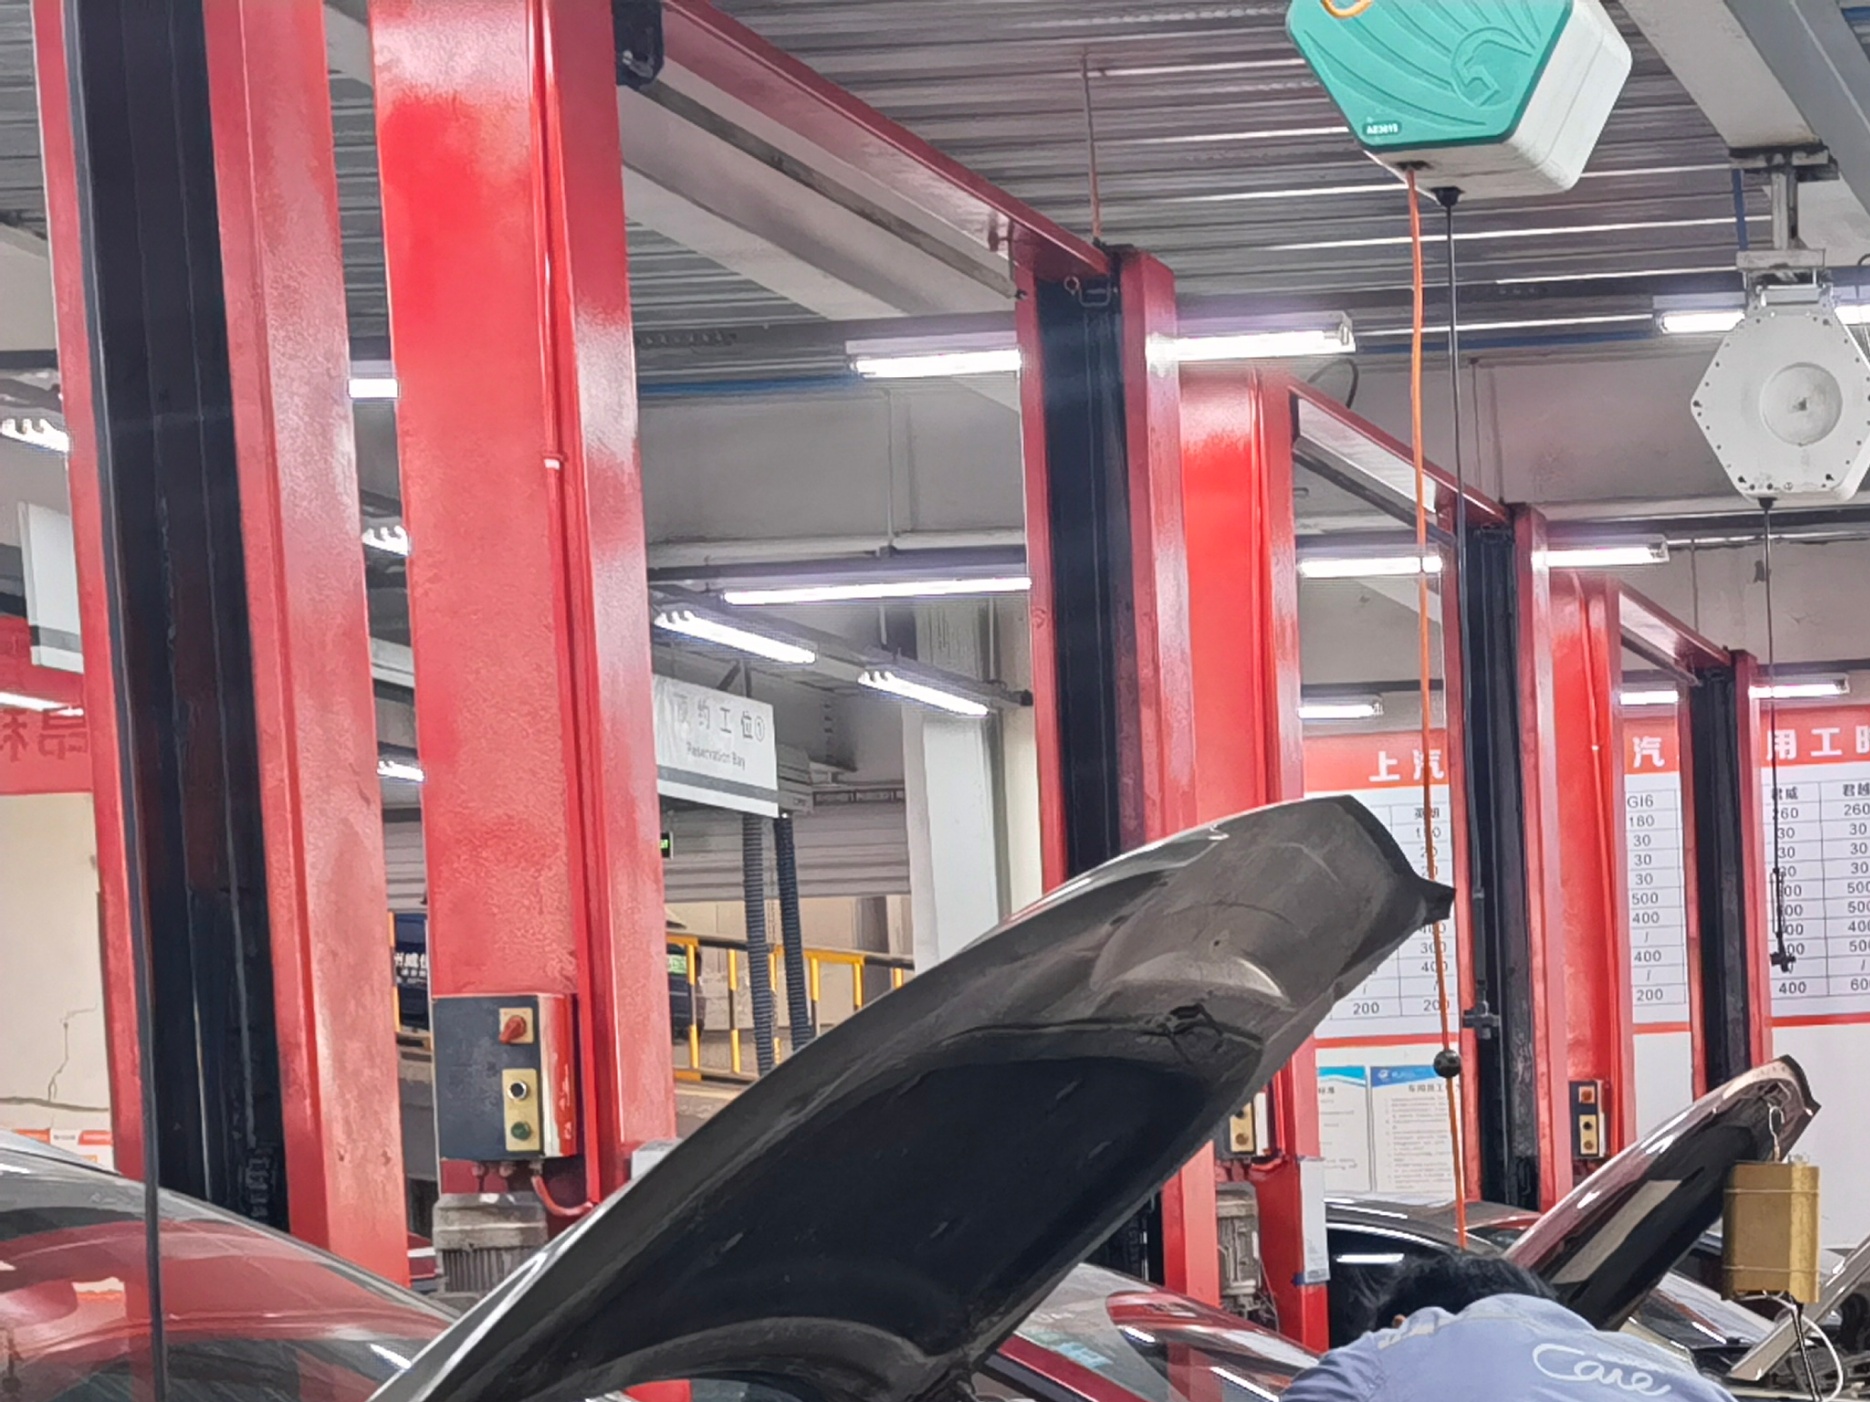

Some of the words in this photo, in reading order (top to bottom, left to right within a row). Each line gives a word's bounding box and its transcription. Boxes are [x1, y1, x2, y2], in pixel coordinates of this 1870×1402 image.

[1629, 816, 1655, 829] 180
[1844, 802, 1870, 816] 260
[1634, 833, 1652, 848] 30
[1850, 822, 1868, 836] 30
[1634, 853, 1652, 866] 30
[1850, 841, 1868, 856] 30
[1636, 872, 1654, 886] 30
[1850, 860, 1870, 874] 30
[1632, 893, 1659, 906] 500
[1633, 912, 1660, 925] 400
[1634, 951, 1661, 964] 400
[1353, 1002, 1380, 1015] 200
[1636, 989, 1663, 1002] 200
[1778, 980, 1806, 994] 400
[1532, 1343, 1672, 1396] Care
